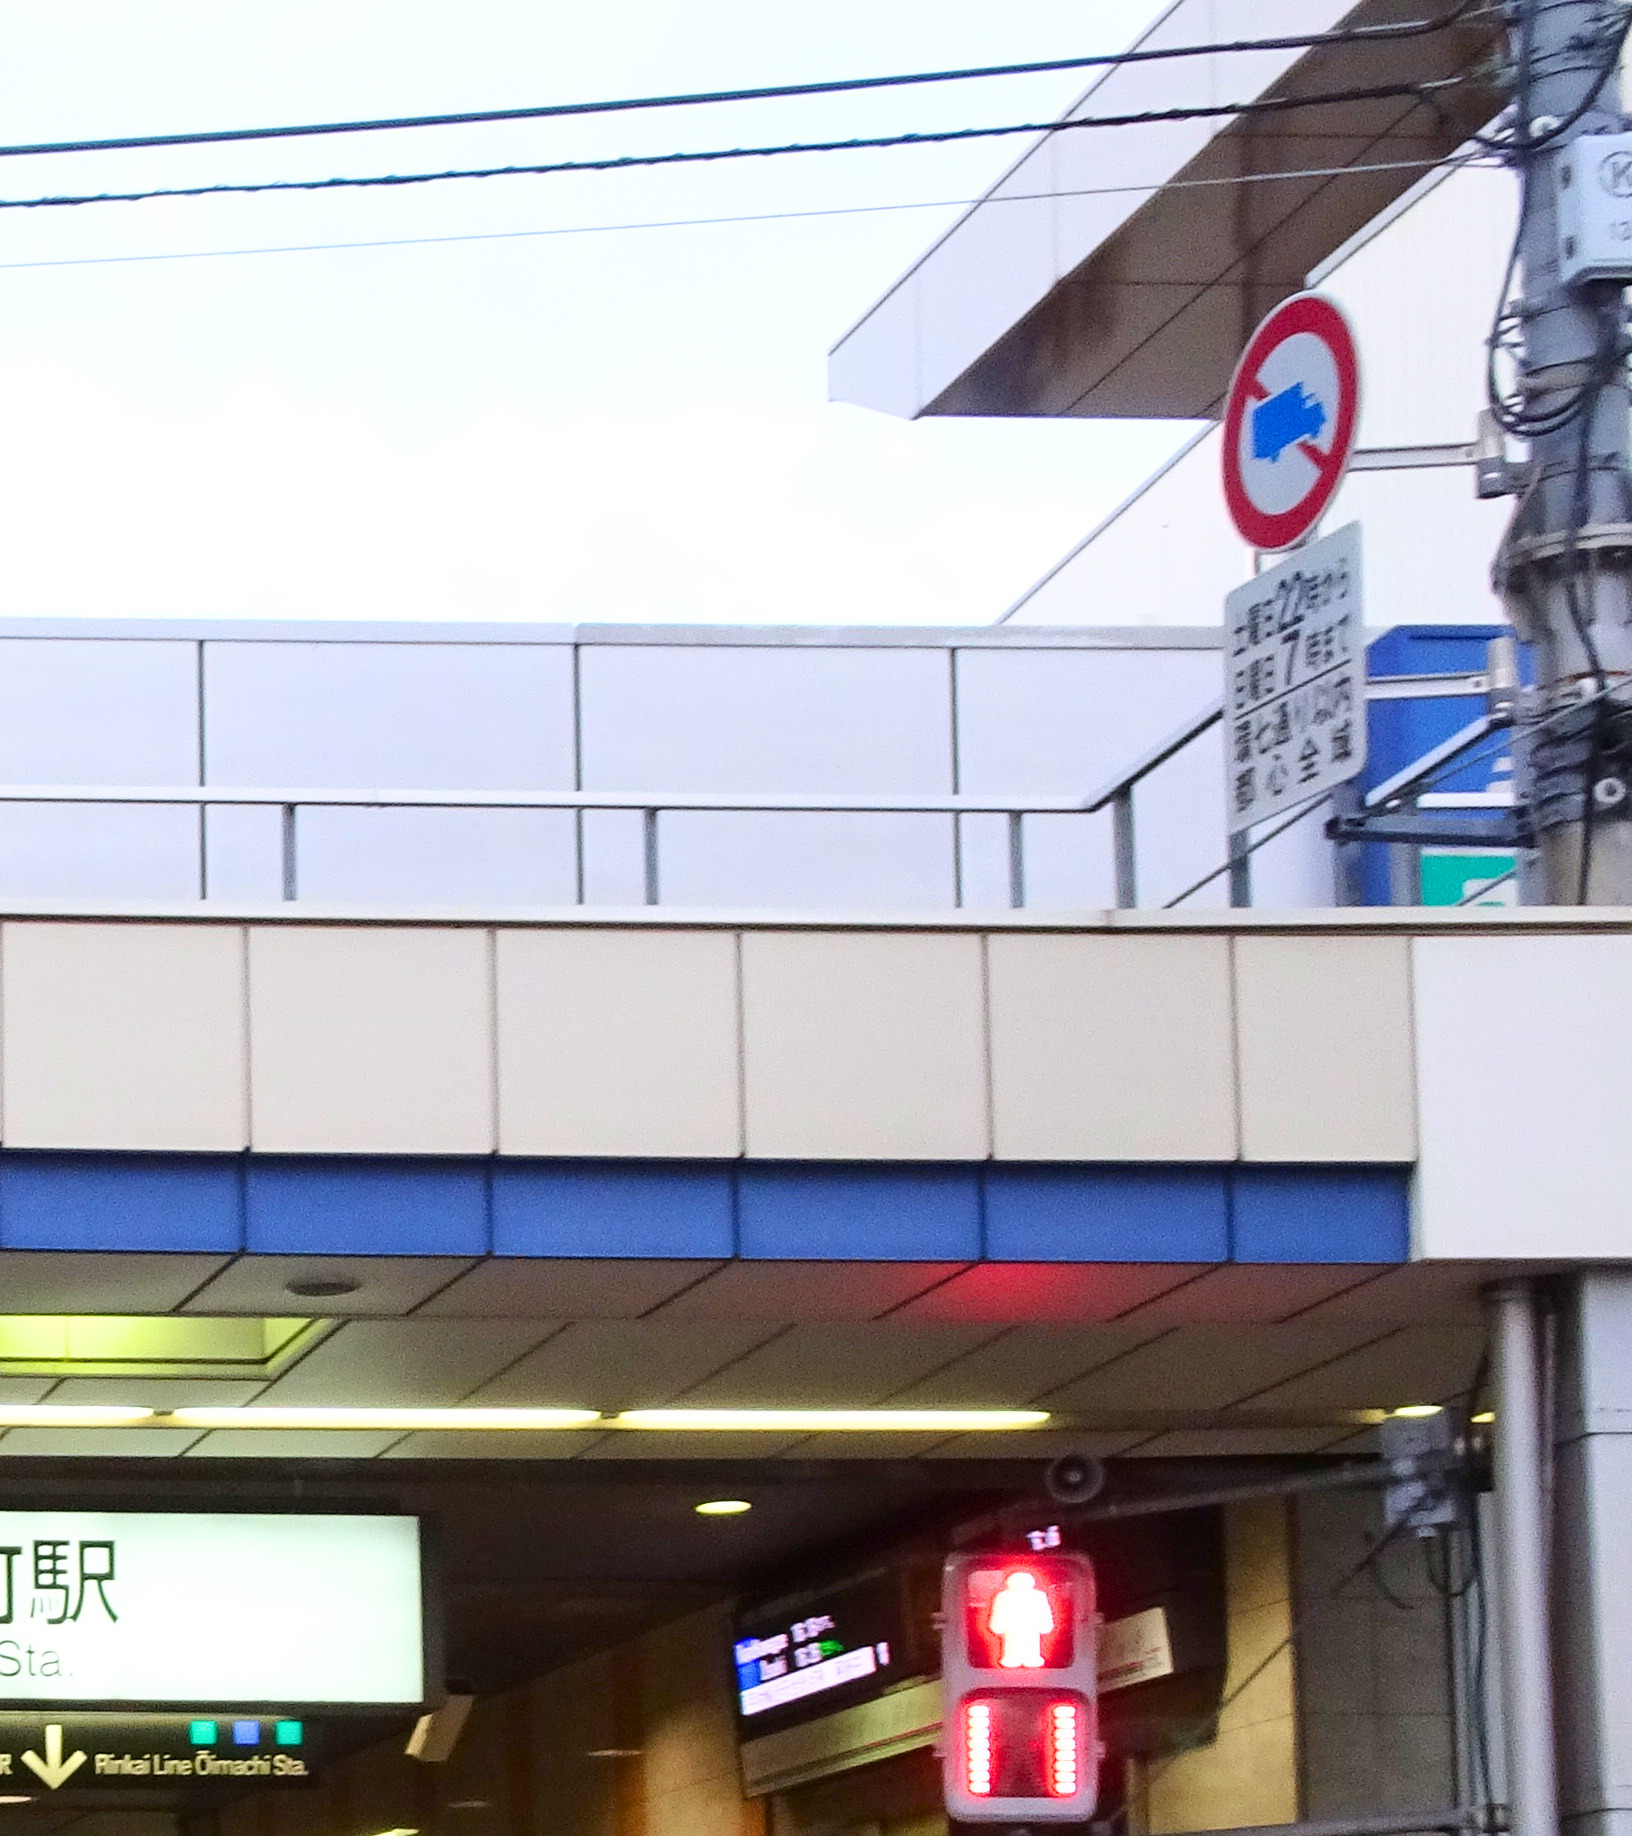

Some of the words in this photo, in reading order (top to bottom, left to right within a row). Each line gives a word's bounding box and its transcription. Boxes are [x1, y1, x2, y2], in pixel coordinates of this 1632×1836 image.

[94, 1753, 151, 1776] Rinkai
[152, 1753, 193, 1776] Line
[272, 1753, 309, 1777] Sta.
